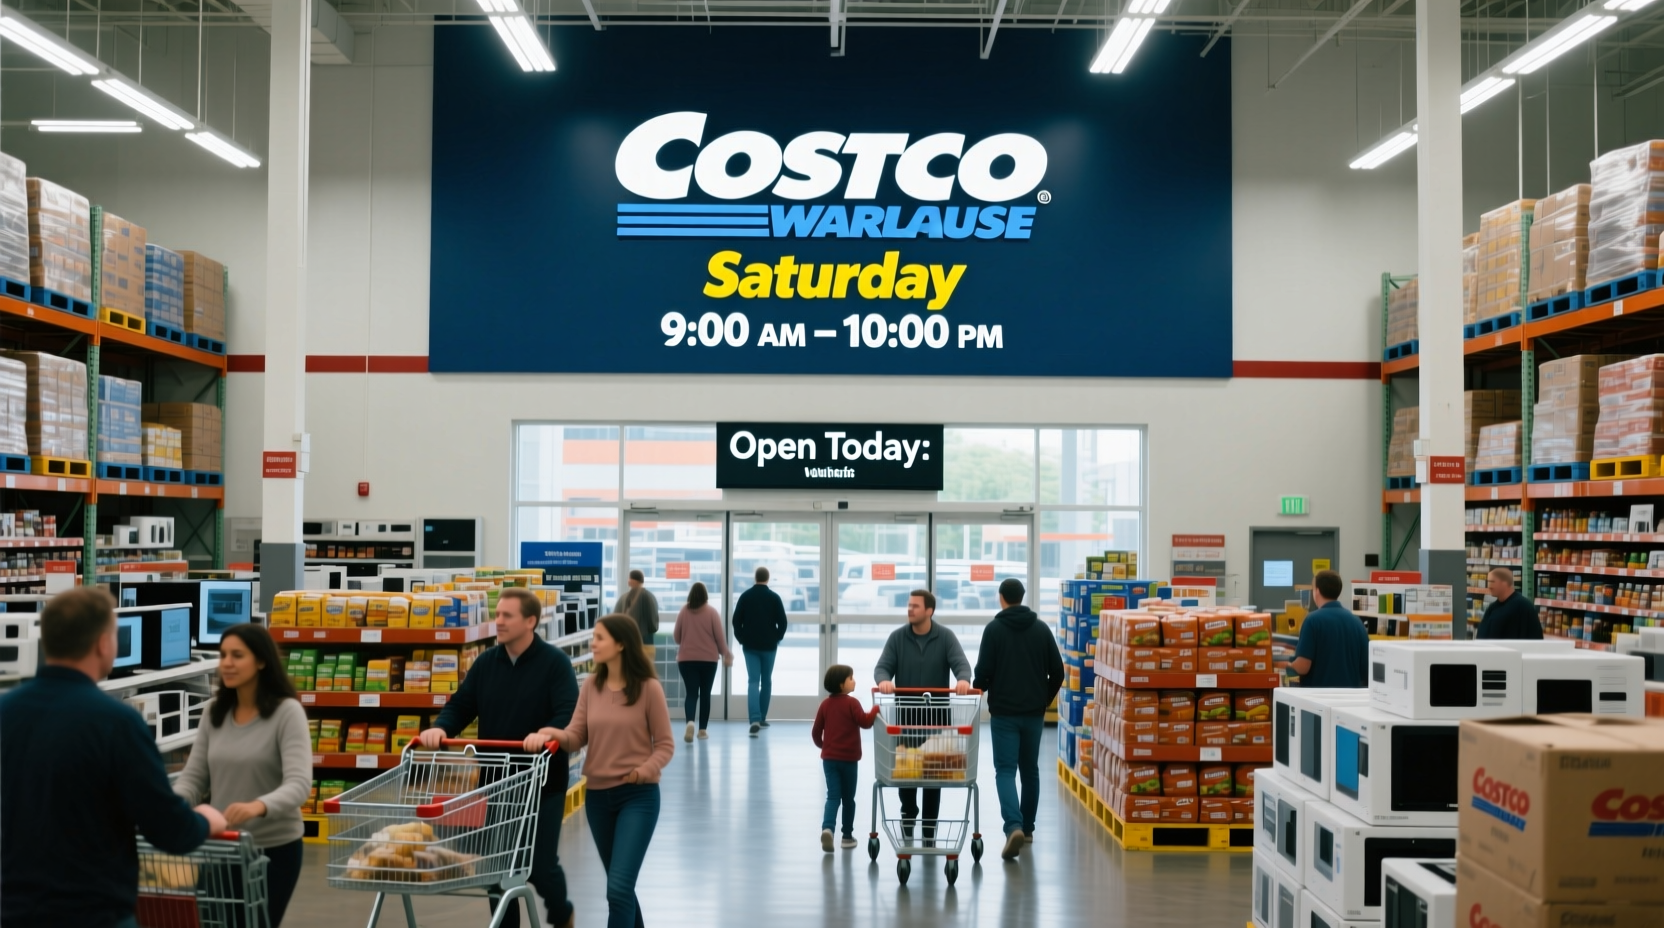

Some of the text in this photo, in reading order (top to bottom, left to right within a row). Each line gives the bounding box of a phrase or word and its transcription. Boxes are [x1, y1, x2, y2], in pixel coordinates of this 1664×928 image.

[615, 112, 1049, 203] COSTCO
[770, 205, 1037, 239] WARLAUSE
[703, 251, 967, 310] Saturday
[660, 312, 750, 348] 9:00
[757, 323, 806, 348] AM
[842, 313, 950, 349] 10:00
[958, 324, 1004, 349] PM
[729, 430, 931, 469] Open Today:
[1472, 766, 1530, 816] COSTCO
